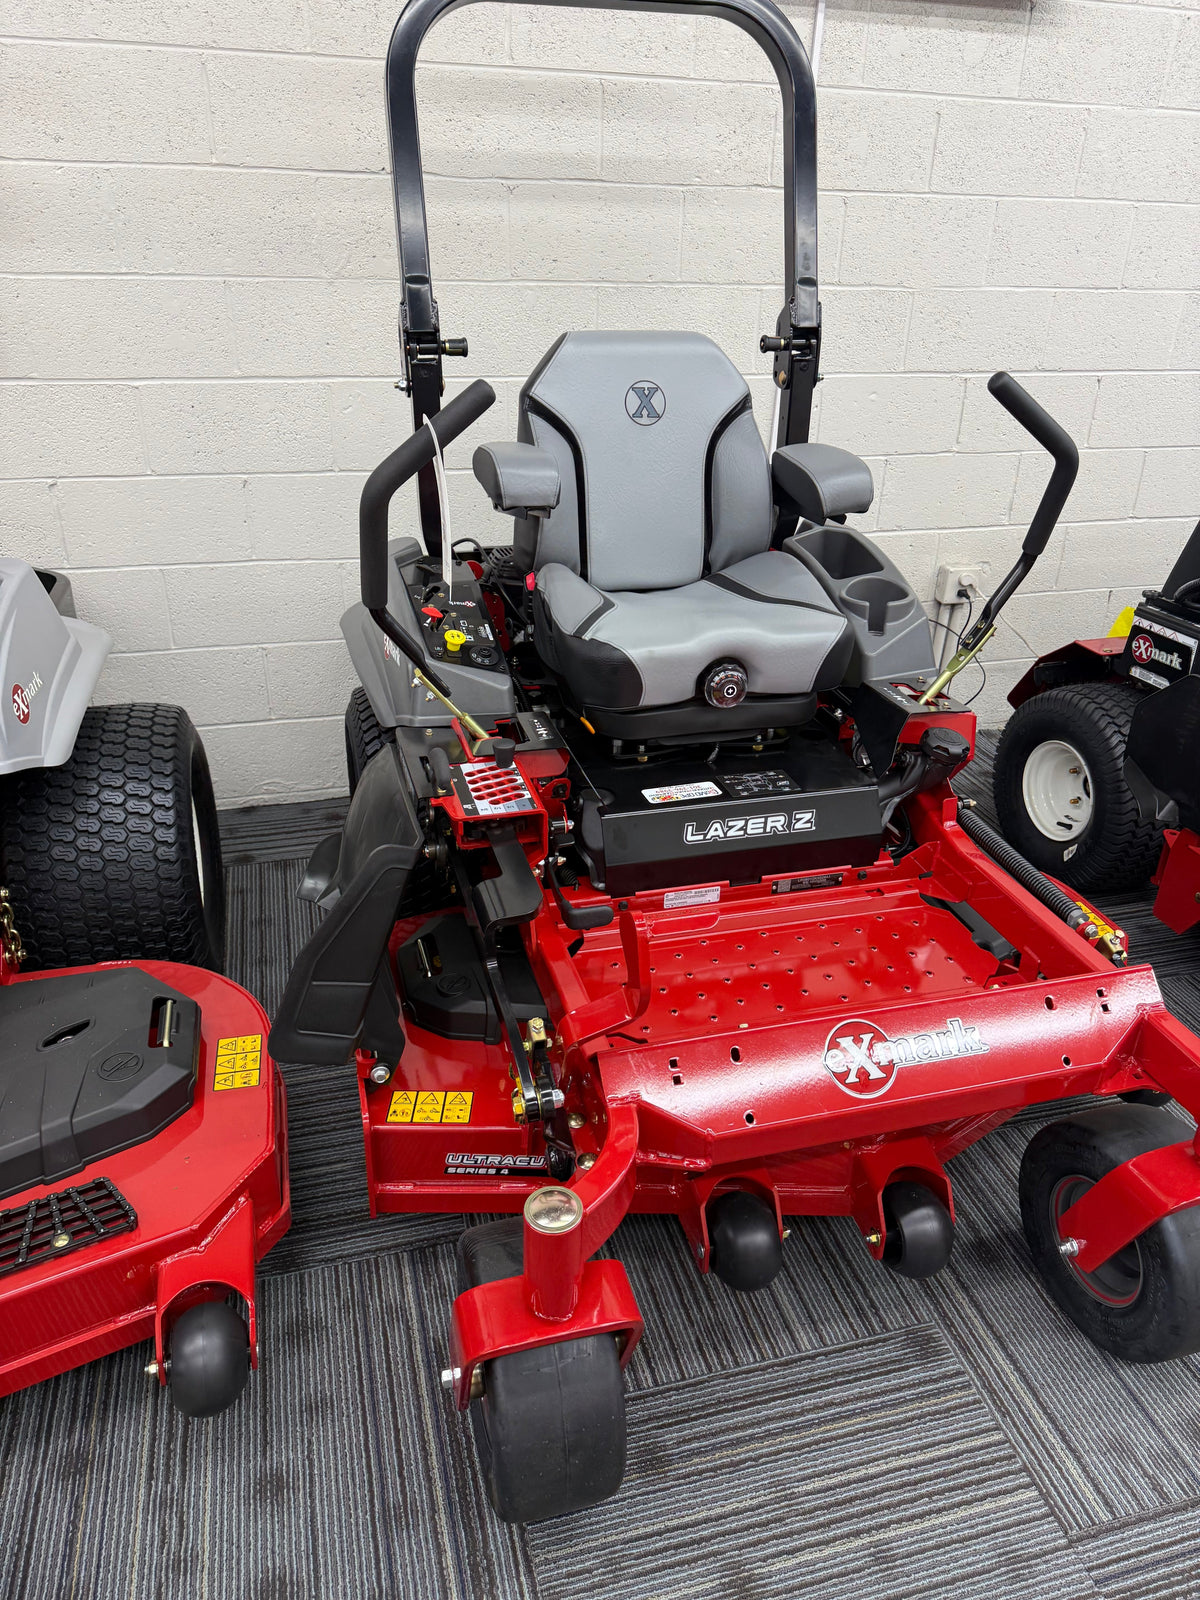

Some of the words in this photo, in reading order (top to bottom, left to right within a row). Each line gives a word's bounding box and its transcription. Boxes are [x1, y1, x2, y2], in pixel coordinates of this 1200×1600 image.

[1132, 638, 1182, 670] eXmark
[13, 671, 43, 720] eXmark
[685, 814, 788, 843] LAZER
[791, 810, 815, 832] Z
[825, 1018, 983, 1085] eXmark
[445, 1153, 547, 1168] ULTRACU
[447, 1167, 496, 1175] SERIES
